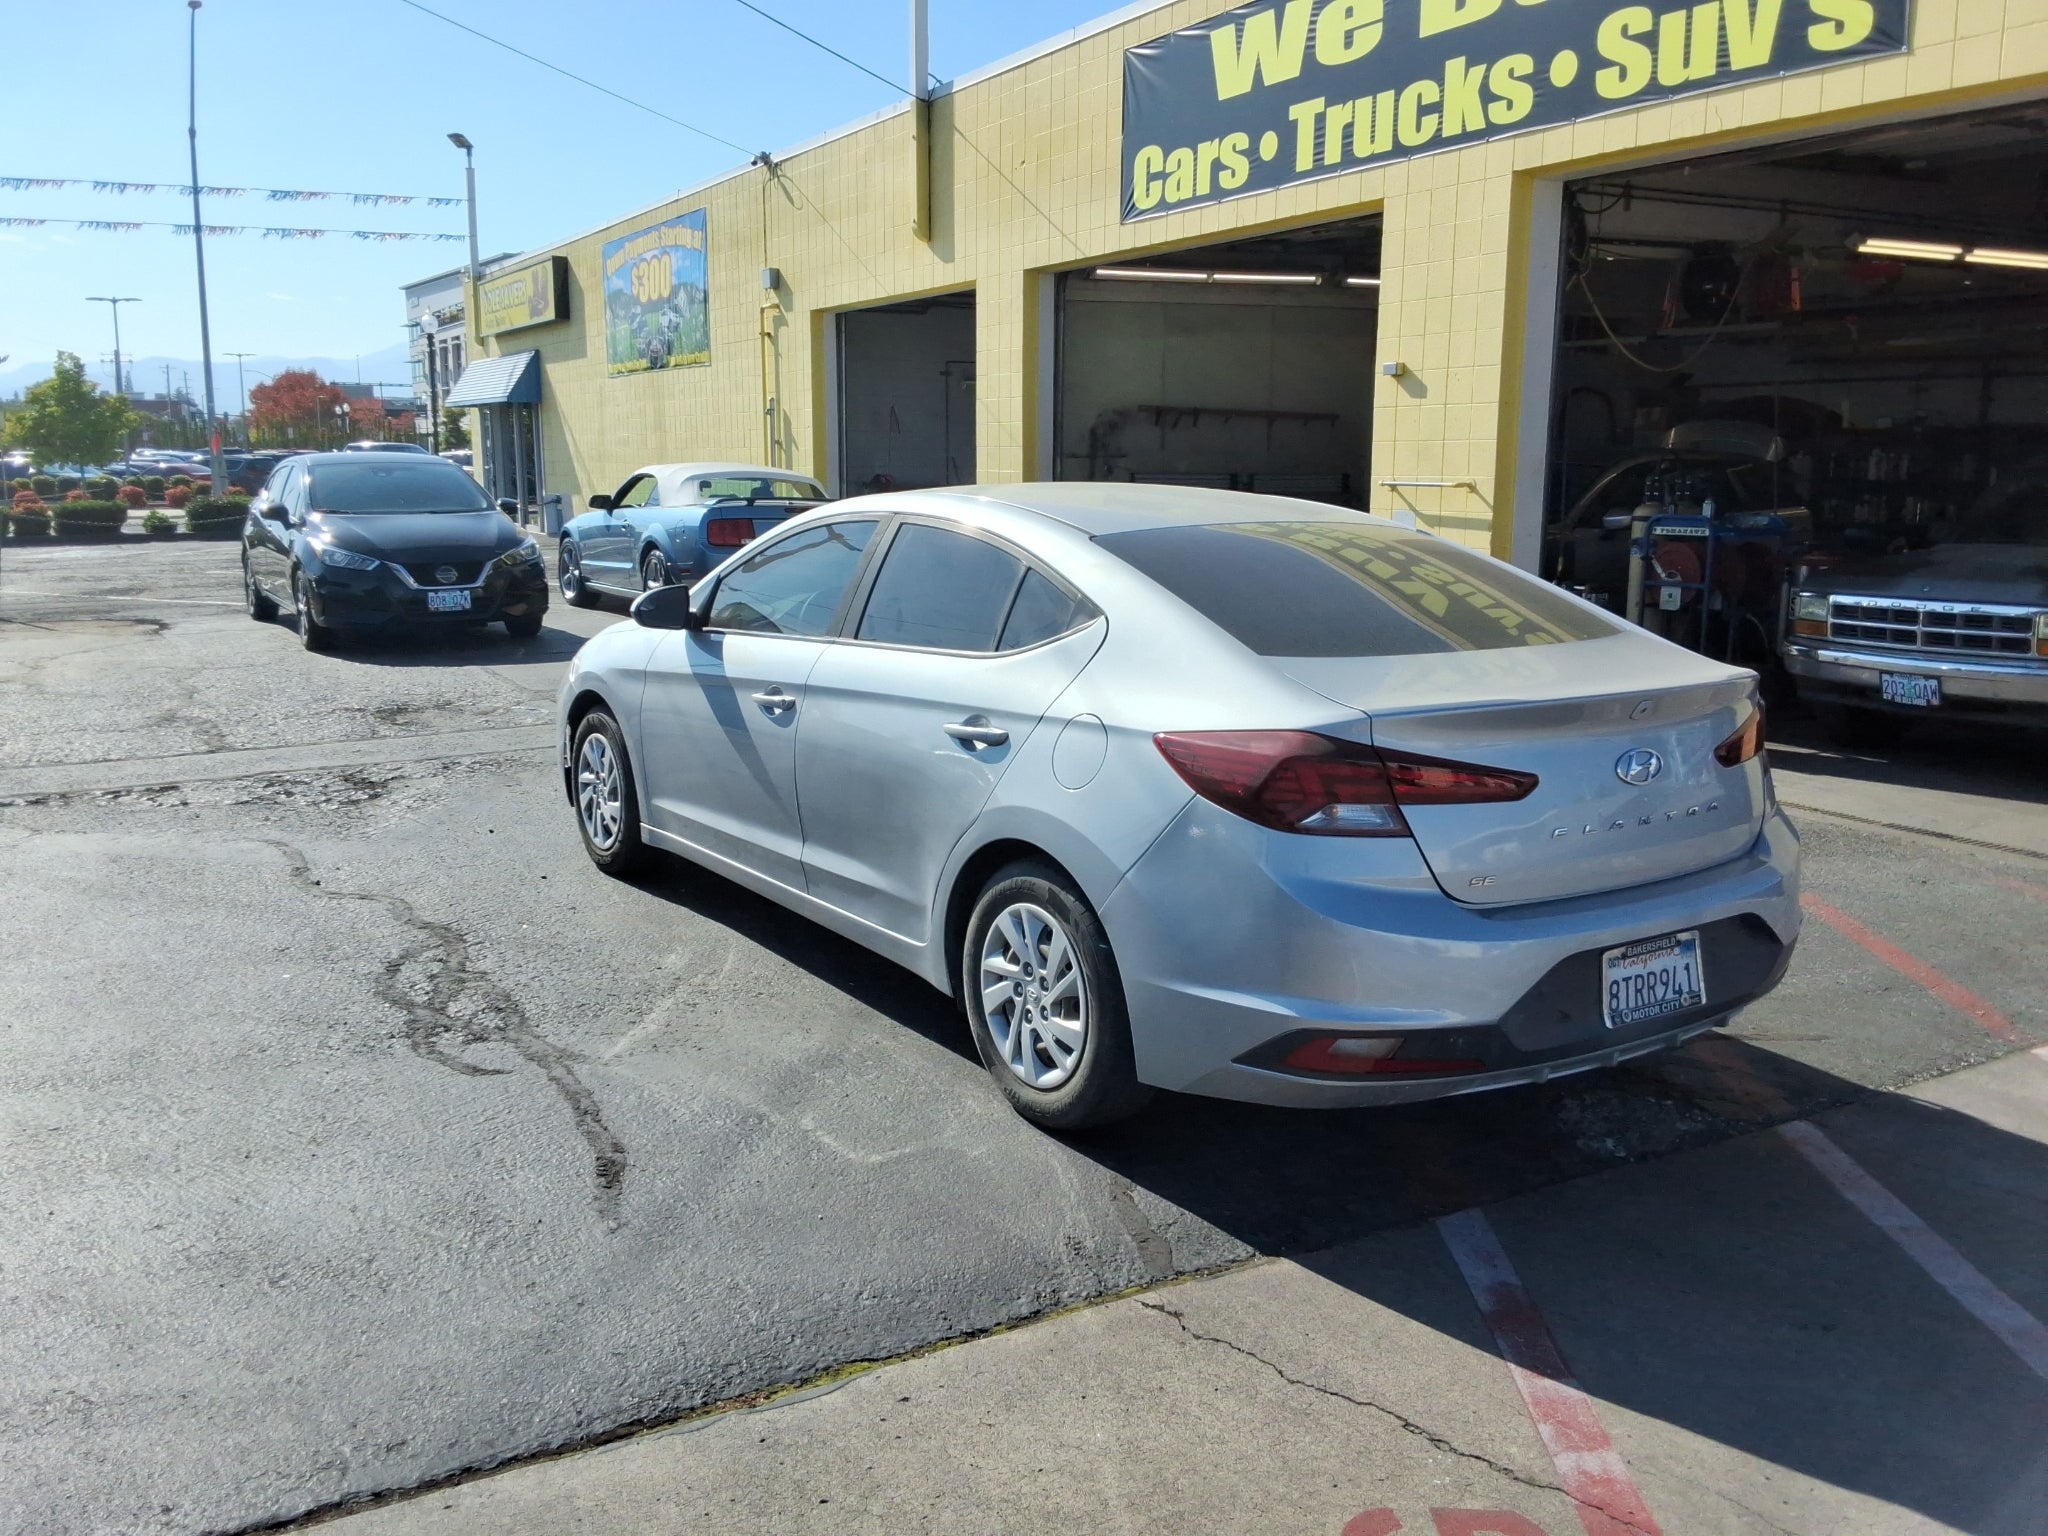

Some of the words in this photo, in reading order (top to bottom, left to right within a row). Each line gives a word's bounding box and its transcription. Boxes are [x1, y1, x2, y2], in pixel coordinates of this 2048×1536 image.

[1210, 0, 1384, 101] We
[1133, 130, 1250, 210] Cars
[1288, 52, 1534, 173] Trucks
[631, 251, 672, 303] $300
[1883, 679, 1906, 698] 203
[1468, 874, 1497, 887] SE
[1627, 938, 1676, 956] BAKERSFIELD
[1608, 962, 1697, 1012] 8TRR941
[1632, 1005, 1661, 1020] MOTOR
[1661, 1000, 1681, 1013] CITY
